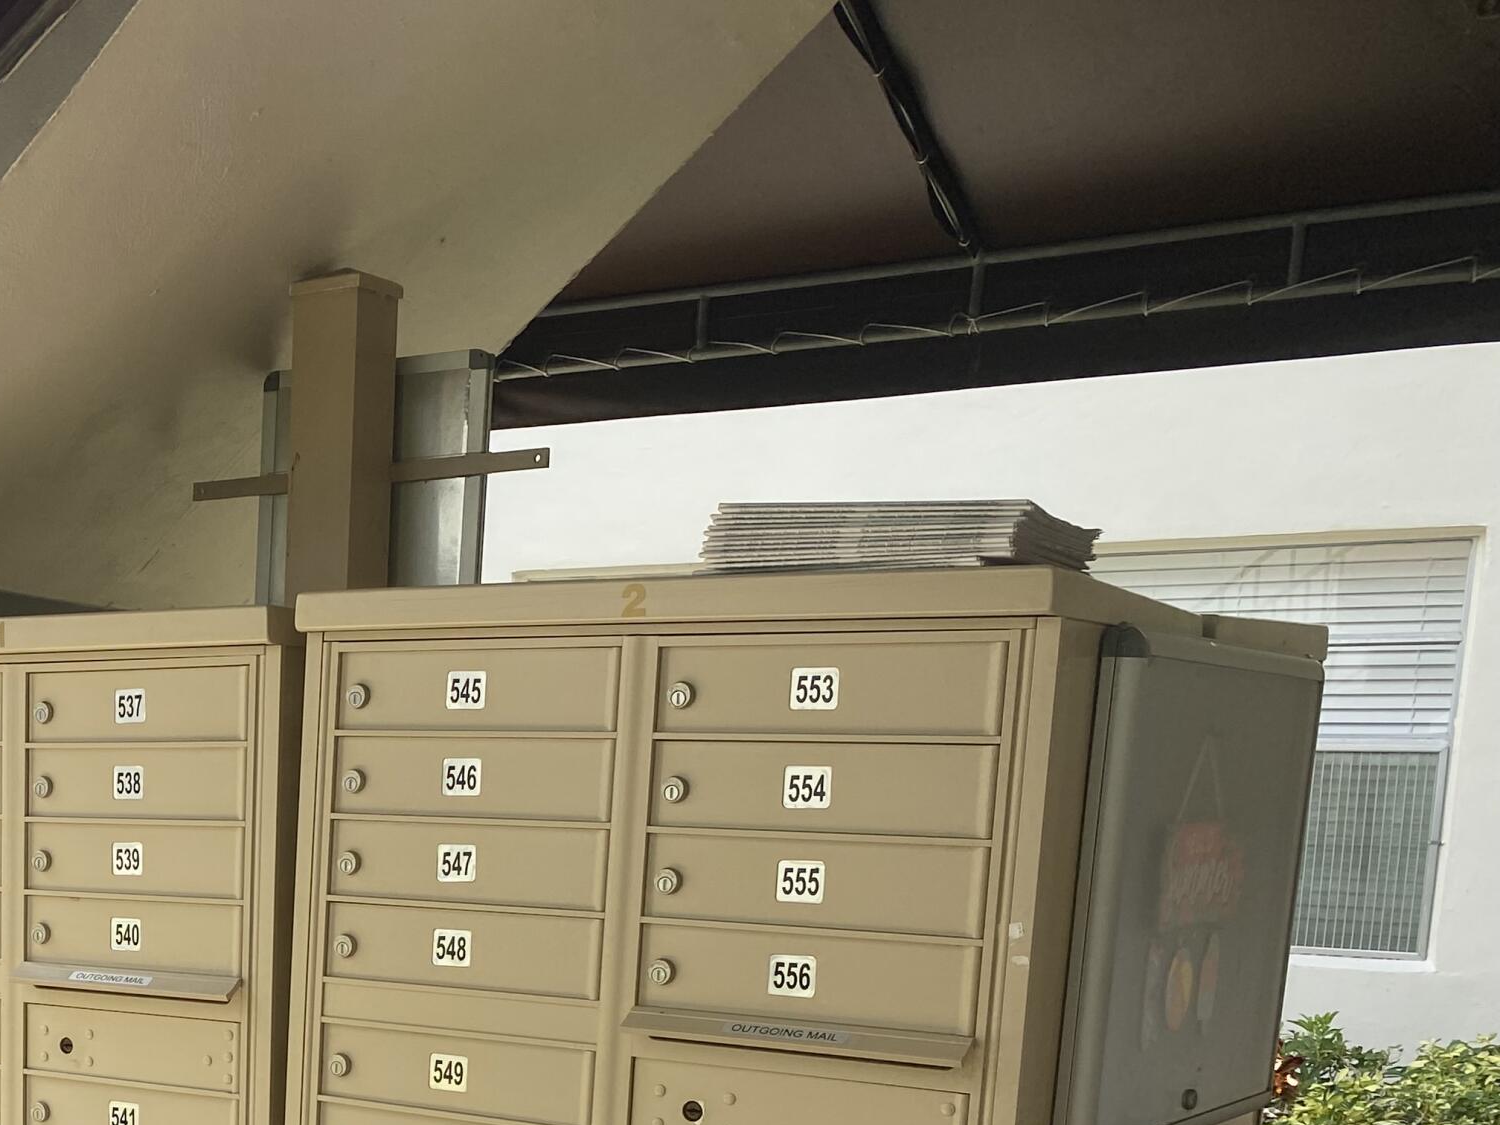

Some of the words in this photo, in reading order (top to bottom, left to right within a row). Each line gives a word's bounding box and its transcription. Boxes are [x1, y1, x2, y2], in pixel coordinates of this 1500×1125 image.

[620, 583, 647, 618] 2
[450, 677, 482, 704] 545
[795, 674, 834, 704] 553
[118, 694, 143, 718] 537
[116, 771, 141, 795] 538
[445, 764, 477, 791] 546
[788, 774, 826, 803] 554
[115, 848, 140, 871] 539
[441, 851, 473, 877] 547
[781, 867, 820, 896] 555
[115, 923, 141, 946] 540
[436, 935, 466, 962] 548
[75, 972, 122, 983] OUTGOING
[123, 976, 144, 985] MAIL
[773, 961, 811, 991] 556
[731, 1023, 804, 1039] OUTGOING
[806, 1031, 837, 1042] MAIL
[433, 1059, 464, 1086] 549
